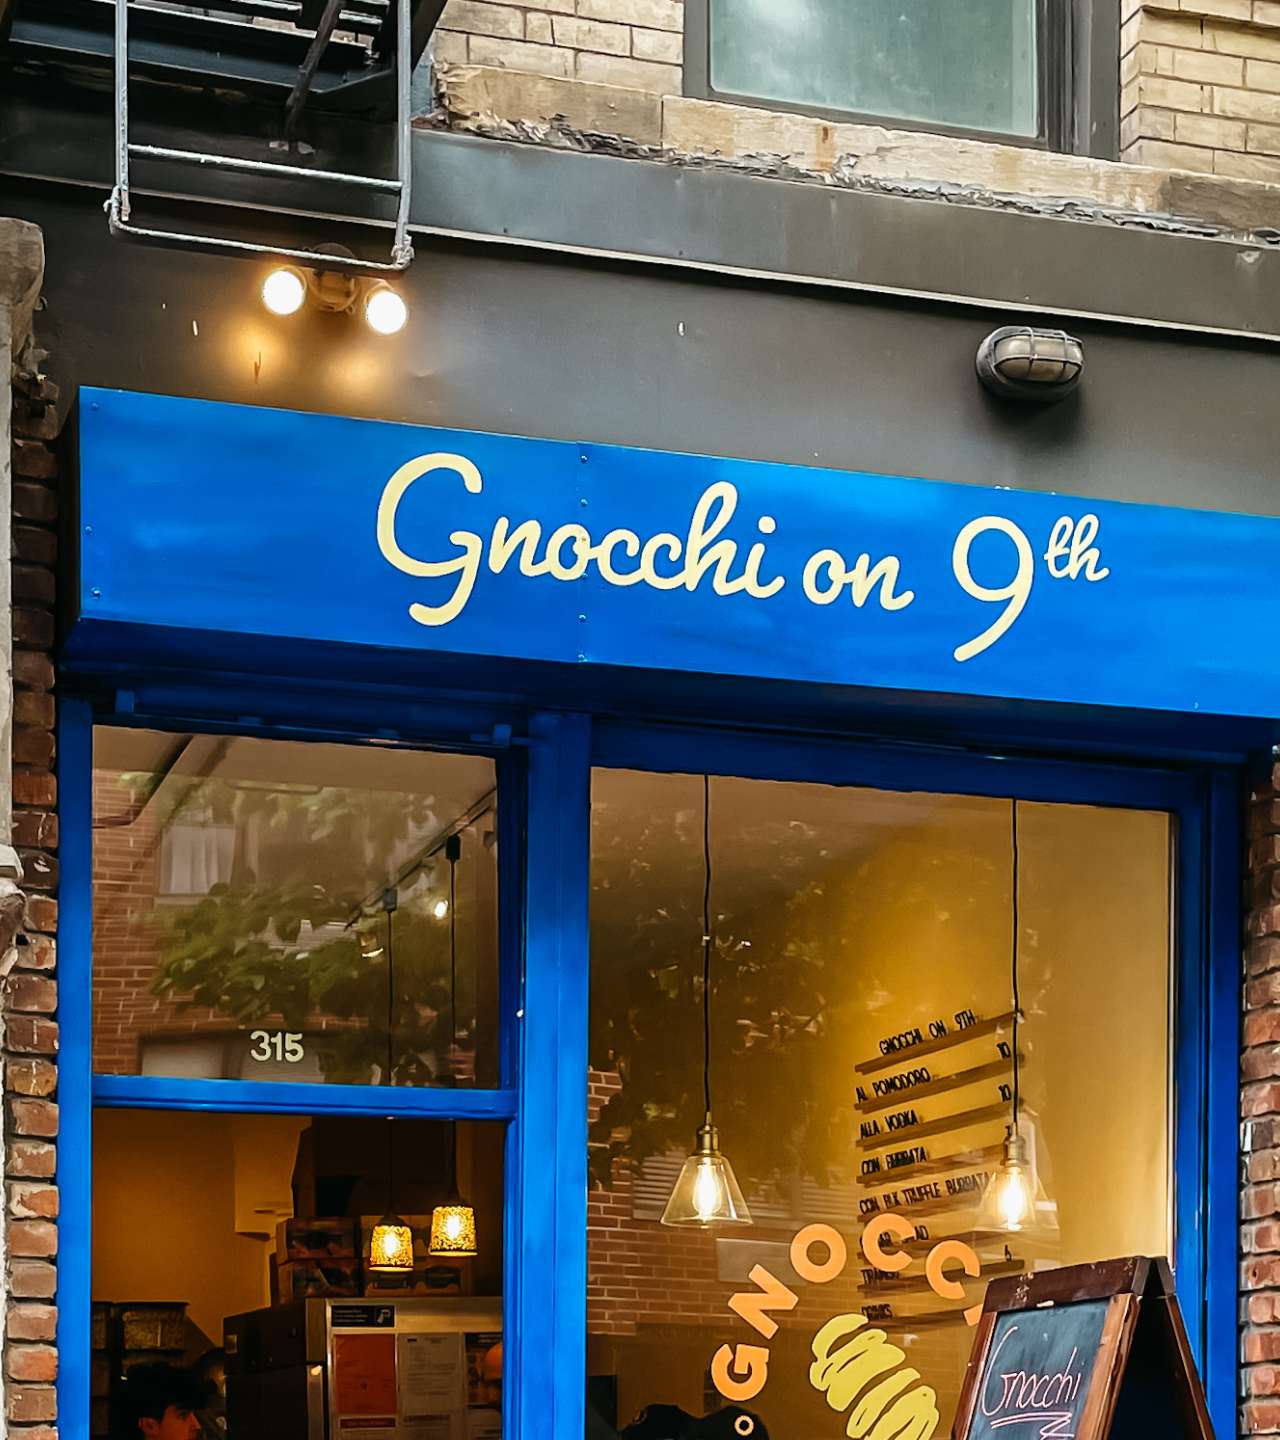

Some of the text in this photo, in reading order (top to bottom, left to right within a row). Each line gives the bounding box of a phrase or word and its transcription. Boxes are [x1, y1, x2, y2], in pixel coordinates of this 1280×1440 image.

[376, 453, 1109, 661] Gnocchi on 9th
[250, 1030, 304, 1062] 315
[879, 1009, 977, 1056] GNOCCHI ON 9TH
[855, 1041, 1011, 1104] AL POMODORO 10
[860, 1084, 1011, 1139] ALLA VODKA 10
[861, 1157, 880, 1176] CON
[859, 1199, 880, 1215] CON
[901, 1182, 941, 1205] TRUFFLE
[711, 1213, 983, 1401] GNOCC
[981, 1326, 1083, 1417] Gnocchi
